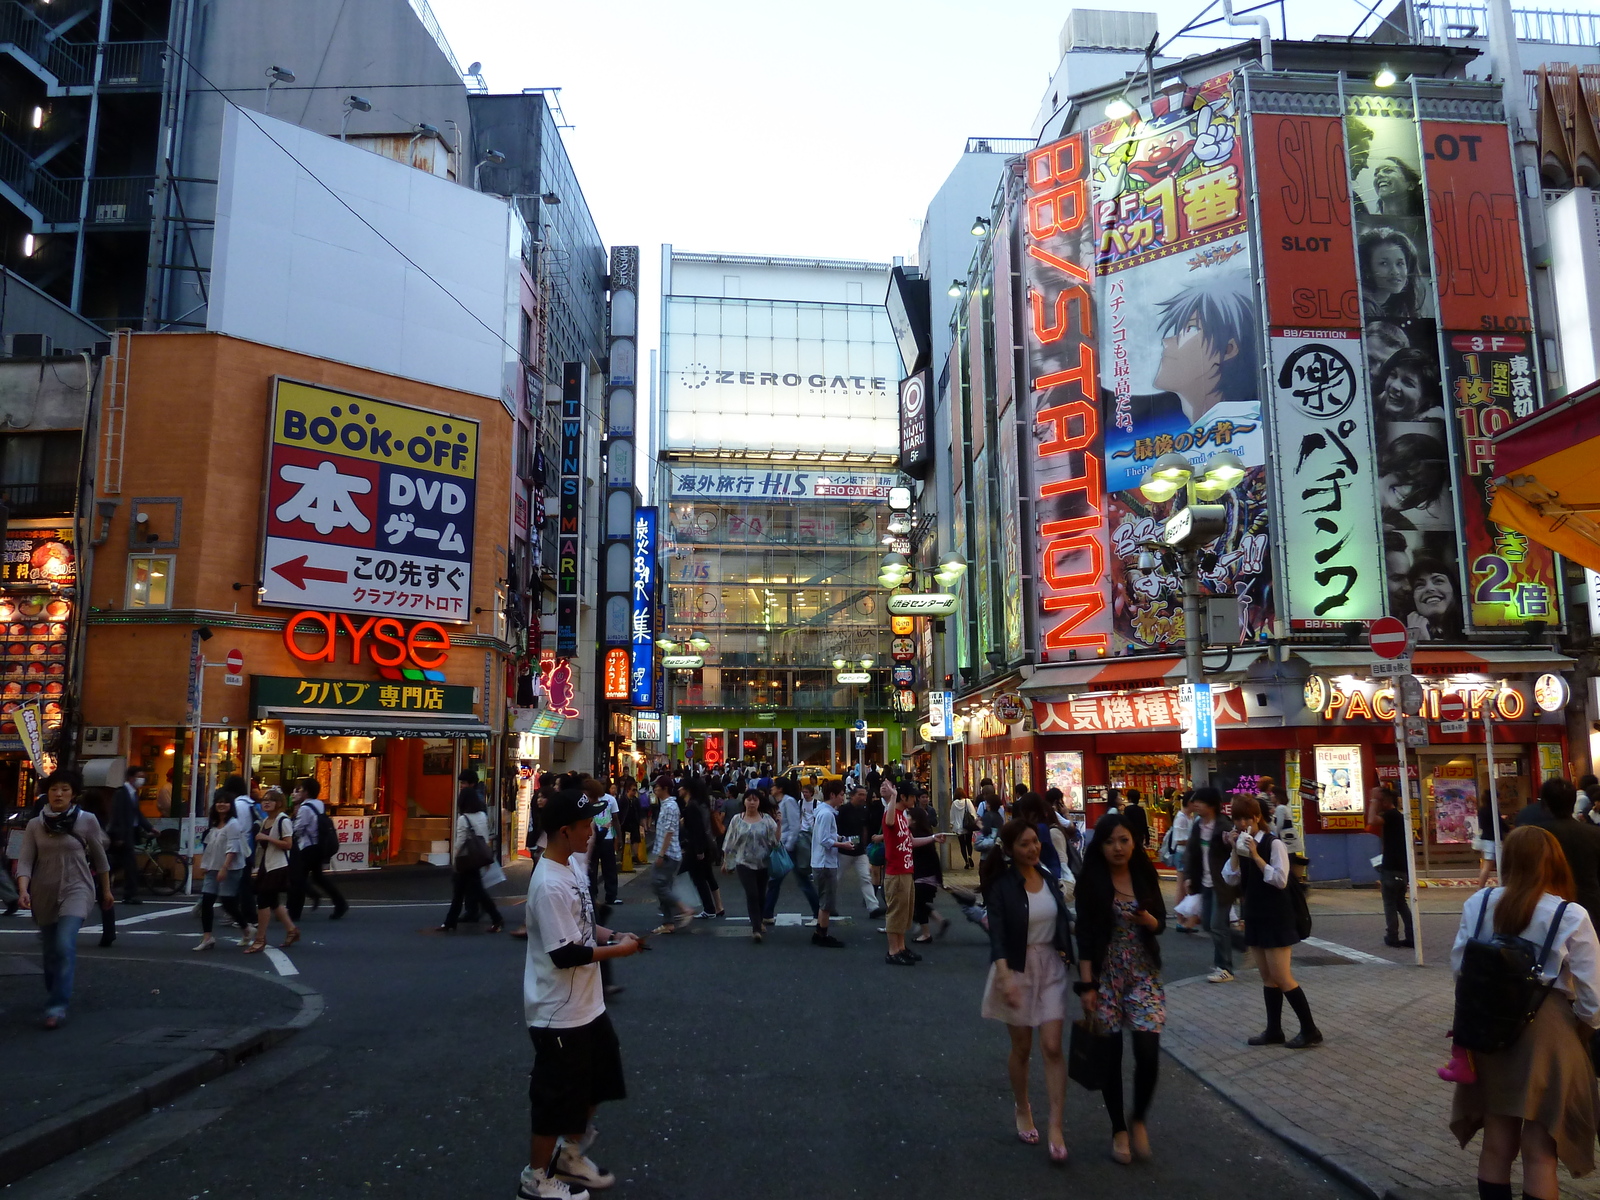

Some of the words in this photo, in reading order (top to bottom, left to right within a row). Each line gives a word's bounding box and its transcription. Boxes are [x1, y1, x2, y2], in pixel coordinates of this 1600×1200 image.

[1100, 193, 1139, 224] 2F
[1143, 164, 1242, 244] 1番
[1101, 219, 1155, 254] ペカ
[1281, 236, 1331, 252] SLOT
[1481, 315, 1530, 331] SLOT
[1283, 329, 1347, 339] BB/STATION
[1471, 337, 1505, 351] 3F
[1109, 279, 1133, 433] パチンコも最高だね。
[1026, 132, 1107, 651] BB/STATION
[903, 420, 924, 440] NIJYU
[903, 432, 925, 452] MARU
[910, 450, 919, 462] 5F
[389, 473, 467, 515] DVD
[677, 474, 755, 494] 海外旅行
[847, 486, 874, 496] GATE
[276, 460, 372, 535] 本
[1294, 420, 1358, 616] パチンコ
[384, 512, 466, 554] ゲーム
[353, 556, 465, 592] この先すぐ
[1472, 553, 1550, 617] 2倍
[352, 587, 464, 613] クラブクアトロ下
[892, 598, 955, 608] 渋谷センター街
[1304, 619, 1371, 629] BB/STAN
[1372, 663, 1409, 674] 自転車を除く
[296, 681, 371, 706] ケバブ
[378, 685, 445, 711] 専門店
[289, 727, 314, 735] アイシェ
[343, 728, 367, 736] アイシェ
[1441, 767, 1473, 777] パチンコ
[1329, 817, 1363, 827] スロット
[338, 831, 363, 843] 客席
[336, 851, 364, 862] ayse
